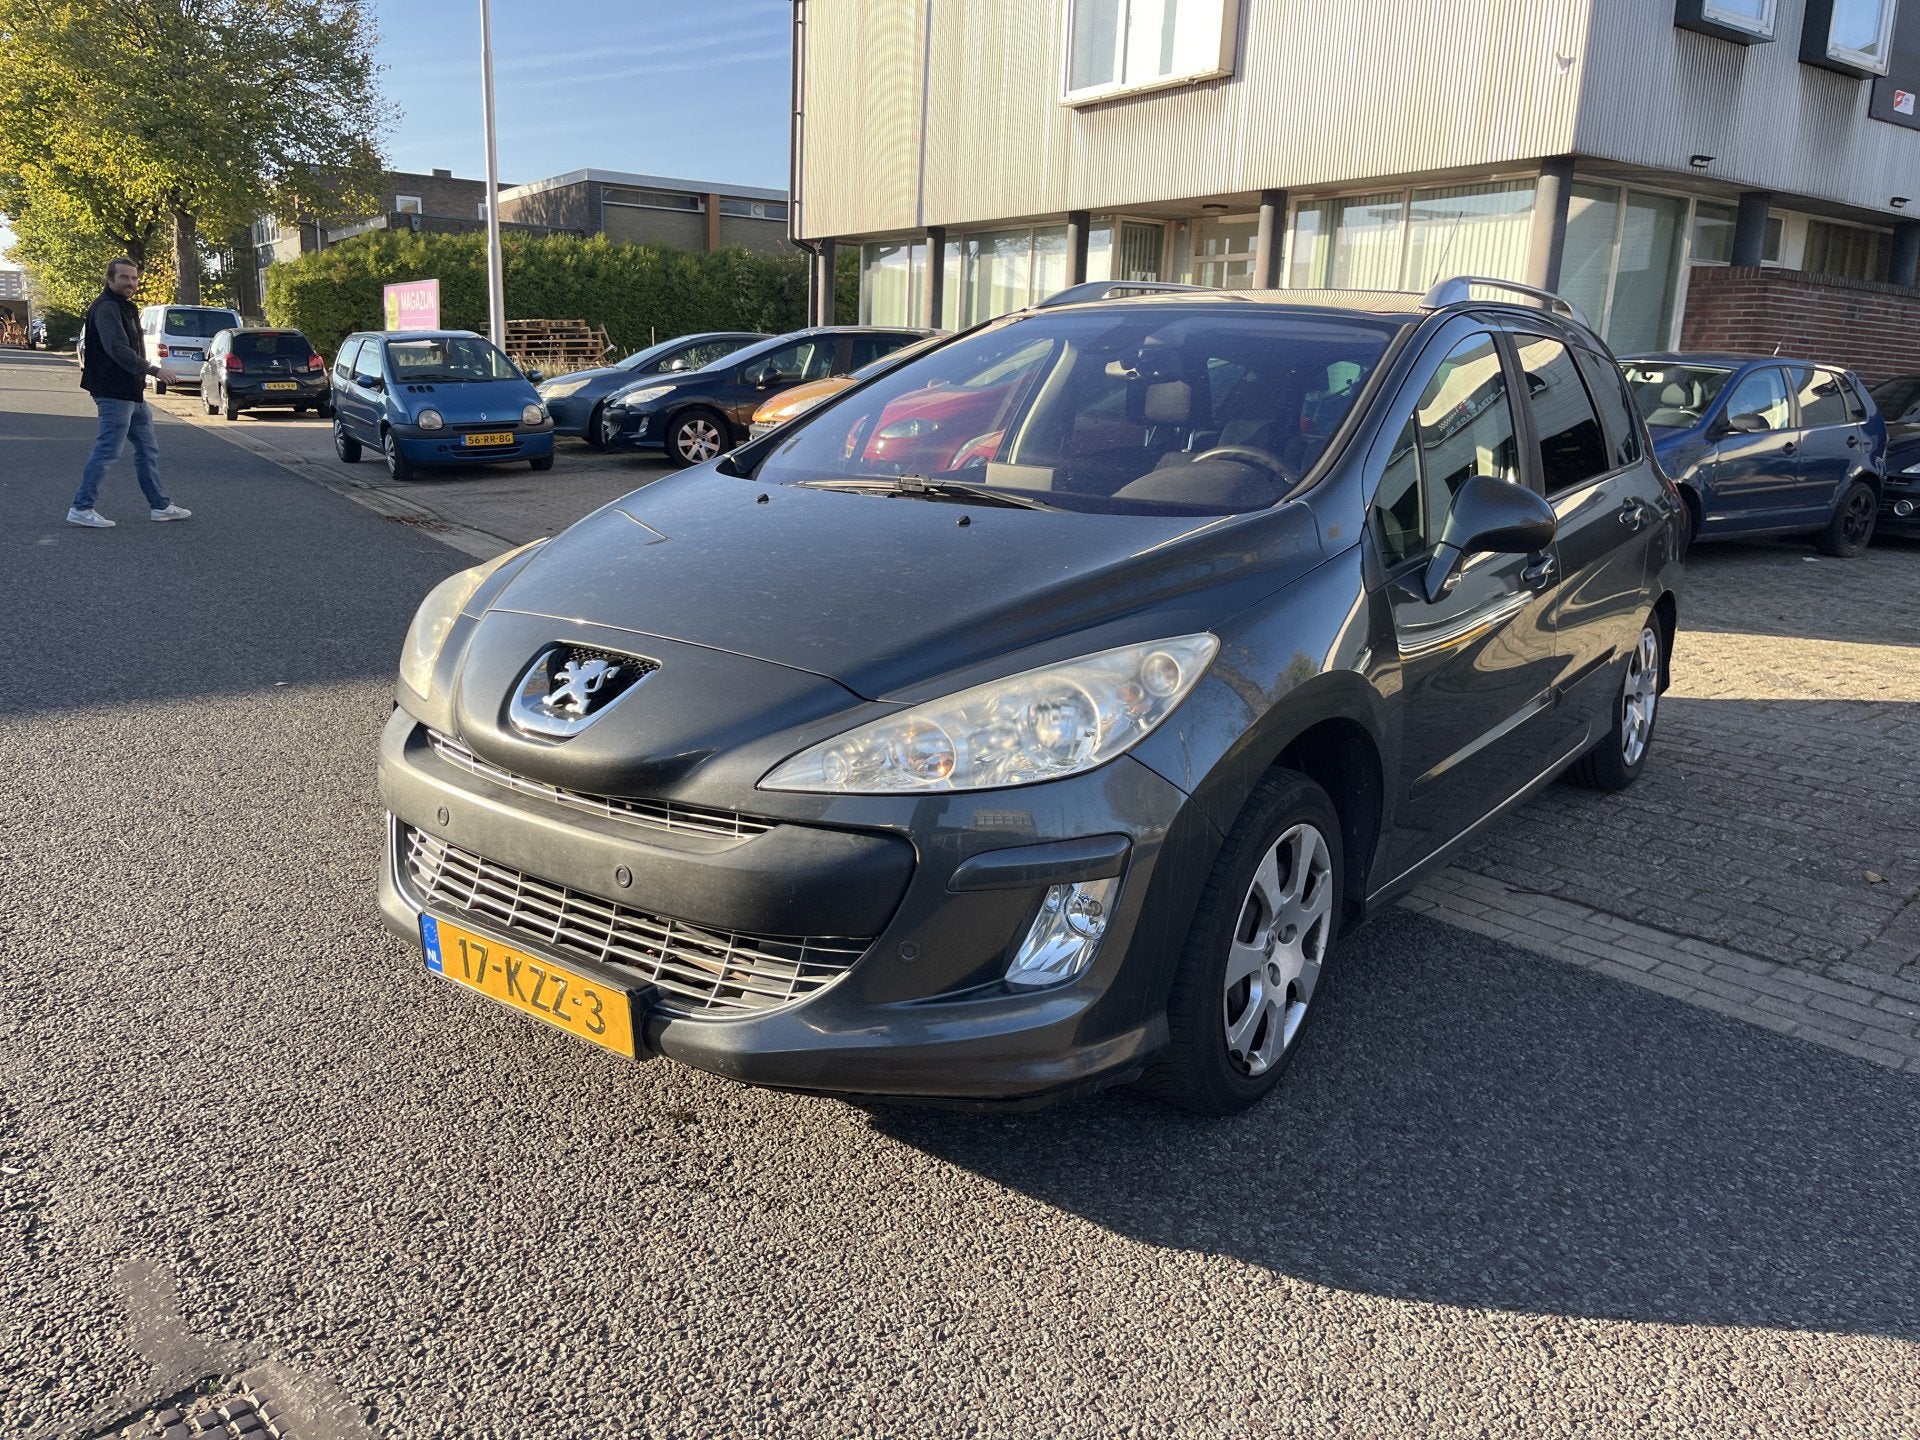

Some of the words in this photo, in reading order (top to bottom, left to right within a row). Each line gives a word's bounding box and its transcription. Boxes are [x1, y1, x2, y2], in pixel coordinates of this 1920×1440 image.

[401, 290, 434, 310] MAGAZIJN
[468, 434, 511, 444] 56-RR-BG
[426, 947, 441, 964] NL
[458, 937, 606, 1035] 17-KZZ-3
